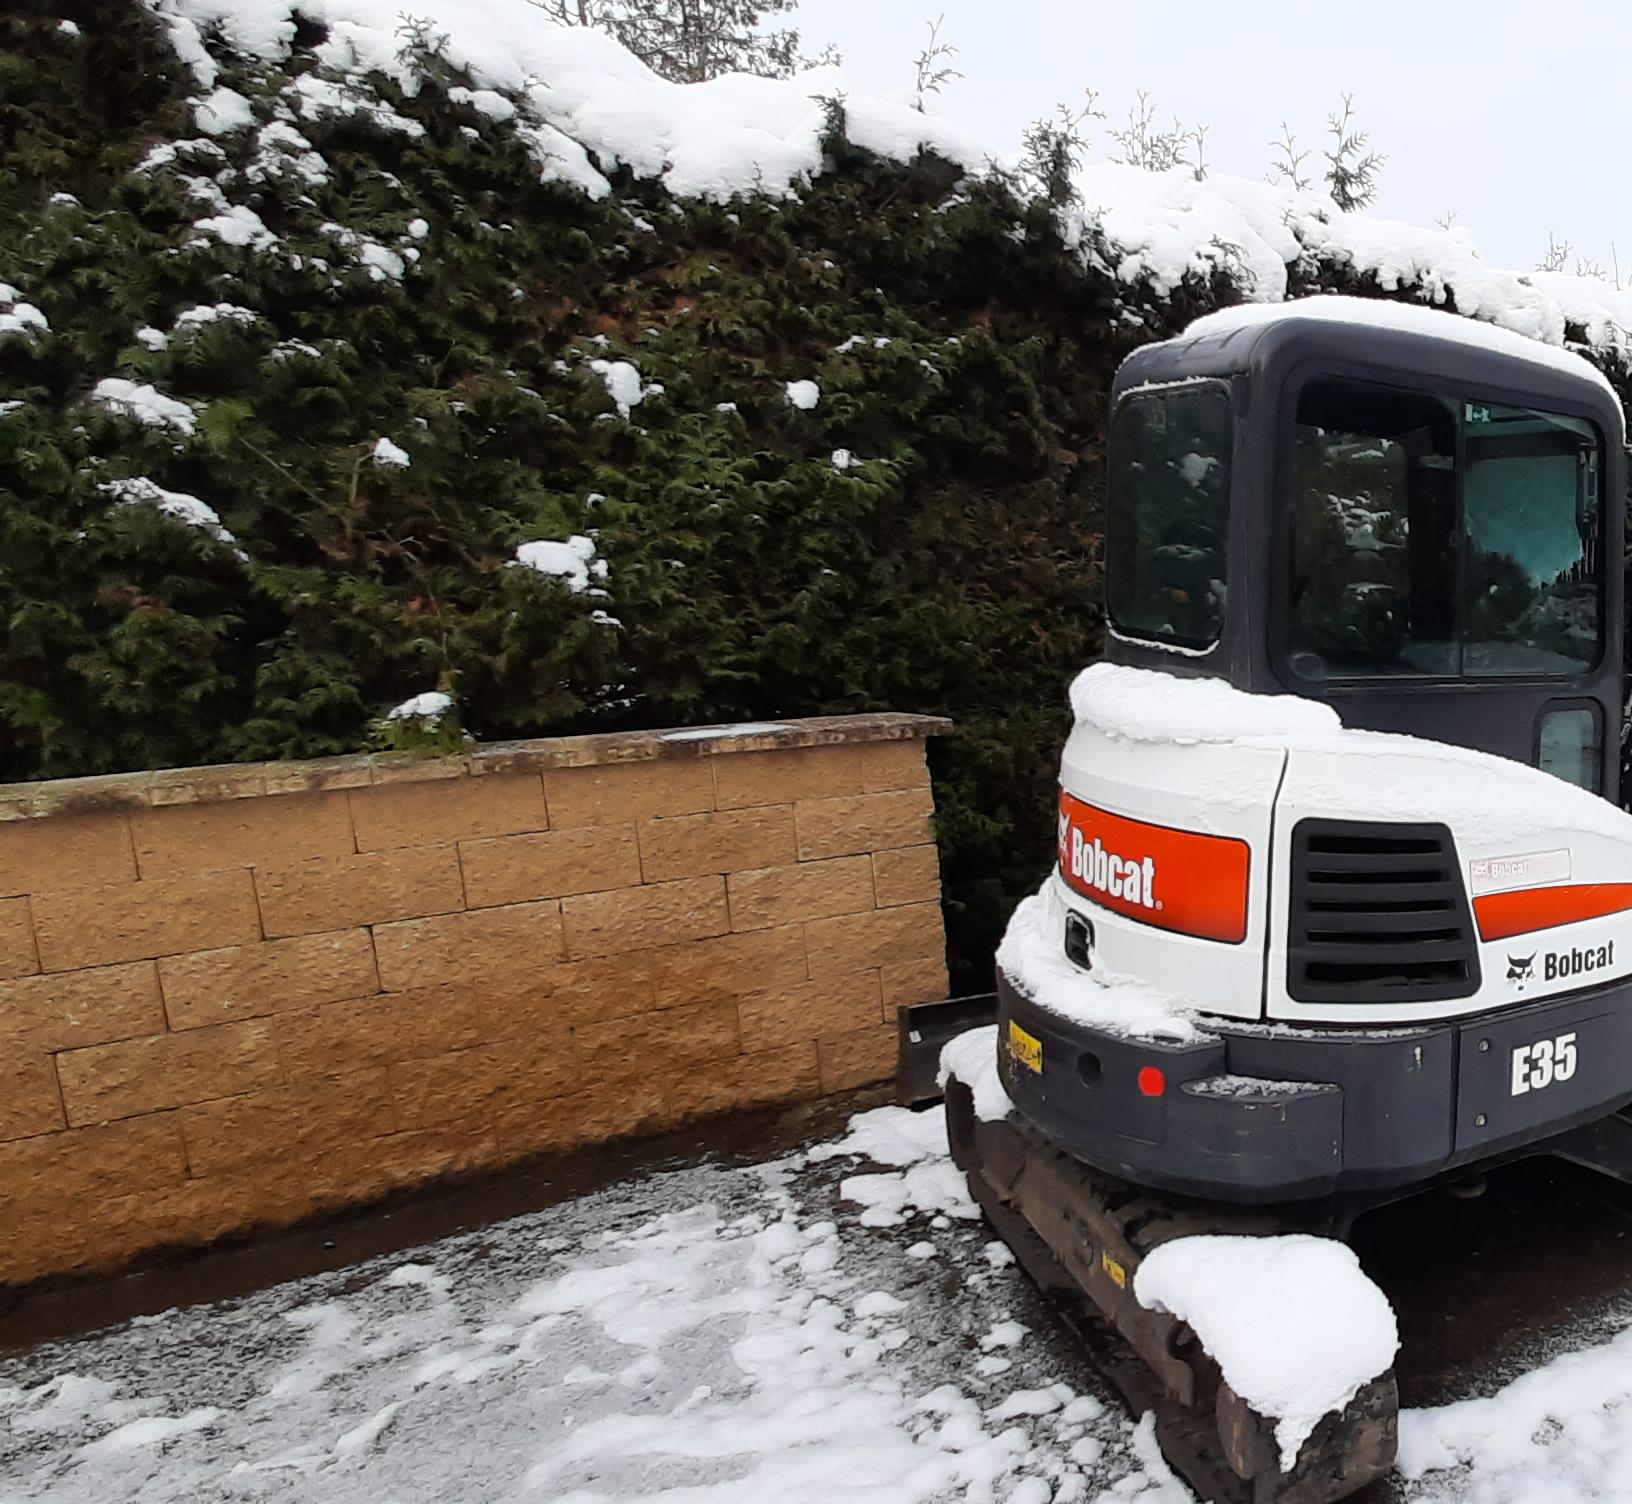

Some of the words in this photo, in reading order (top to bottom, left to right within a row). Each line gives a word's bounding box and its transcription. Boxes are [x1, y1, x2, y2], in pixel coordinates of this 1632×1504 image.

[1071, 826, 1154, 909] Bobcat
[1491, 861, 1528, 878] Bobcat
[1544, 940, 1614, 982] Bobcat
[1511, 1032, 1577, 1096] E35
